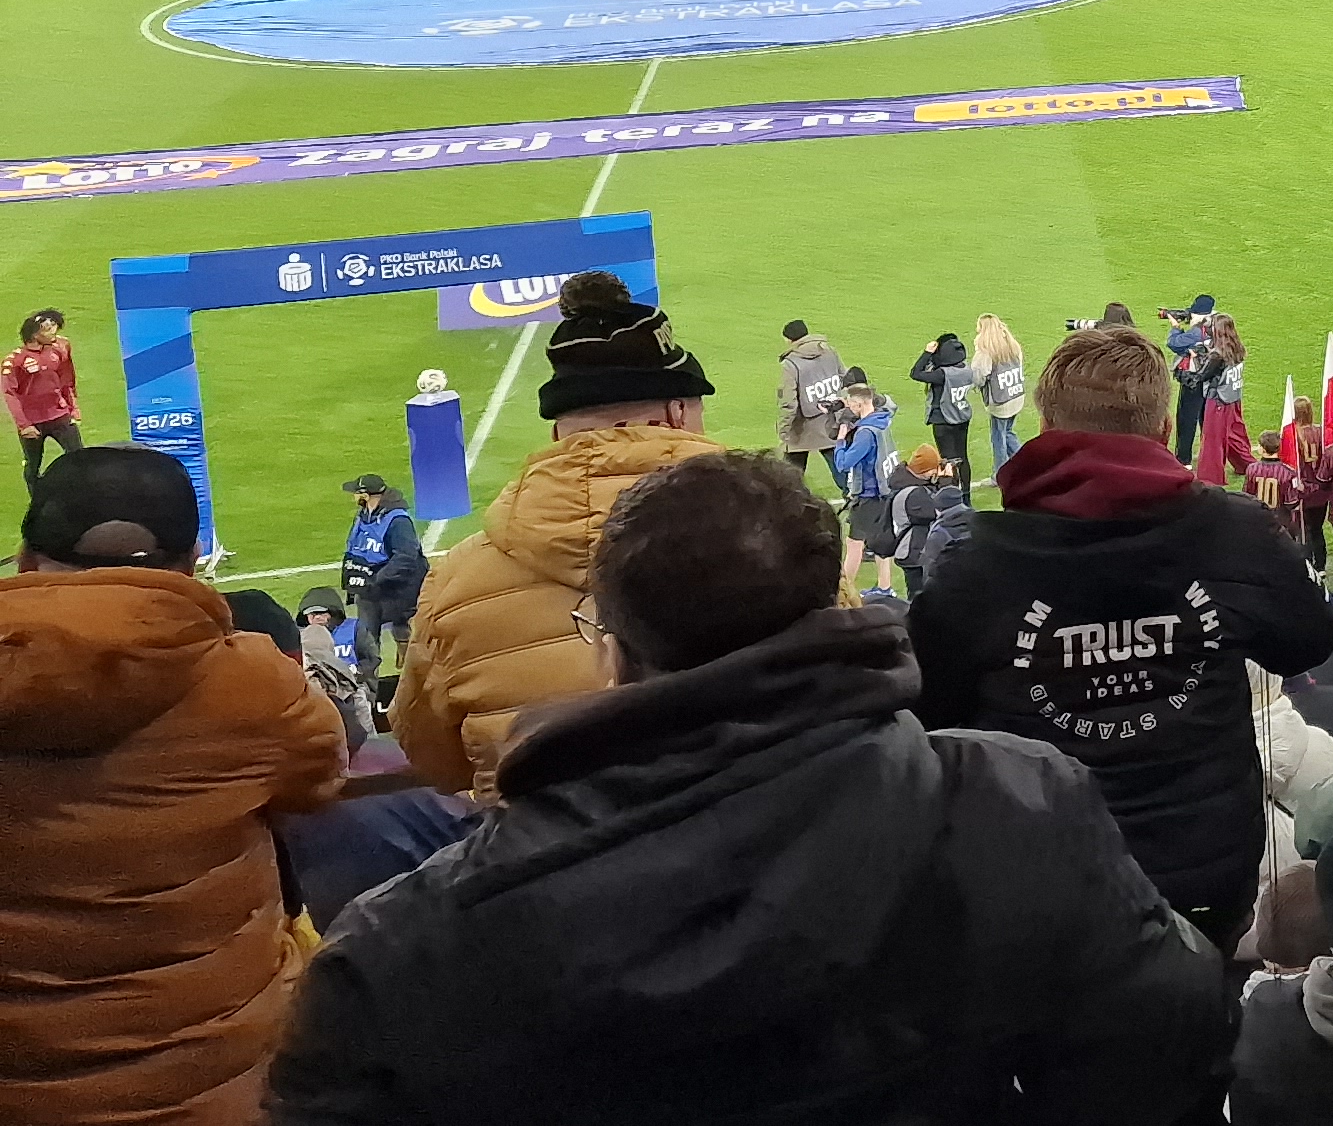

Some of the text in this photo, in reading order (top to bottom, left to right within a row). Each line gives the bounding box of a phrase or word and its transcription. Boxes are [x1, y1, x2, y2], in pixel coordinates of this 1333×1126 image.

[21, 160, 203, 189] LOTTO
[288, 132, 552, 167] zagraj
[581, 116, 773, 145] teraz
[803, 108, 890, 128] na
[380, 253, 402, 264] PKO
[381, 254, 502, 280] EKSTRAKLASA
[1226, 363, 1243, 384] FOT
[805, 374, 840, 403] FOTO
[951, 385, 969, 403] FOT
[136, 412, 193, 430] 25/26
[1255, 476, 1279, 509] 10
[1053, 614, 1182, 668] TRUST
[1086, 680, 1154, 700] IDEAS
[1091, 670, 1149, 687] YOUR
[1029, 684, 1157, 740] STARTED
